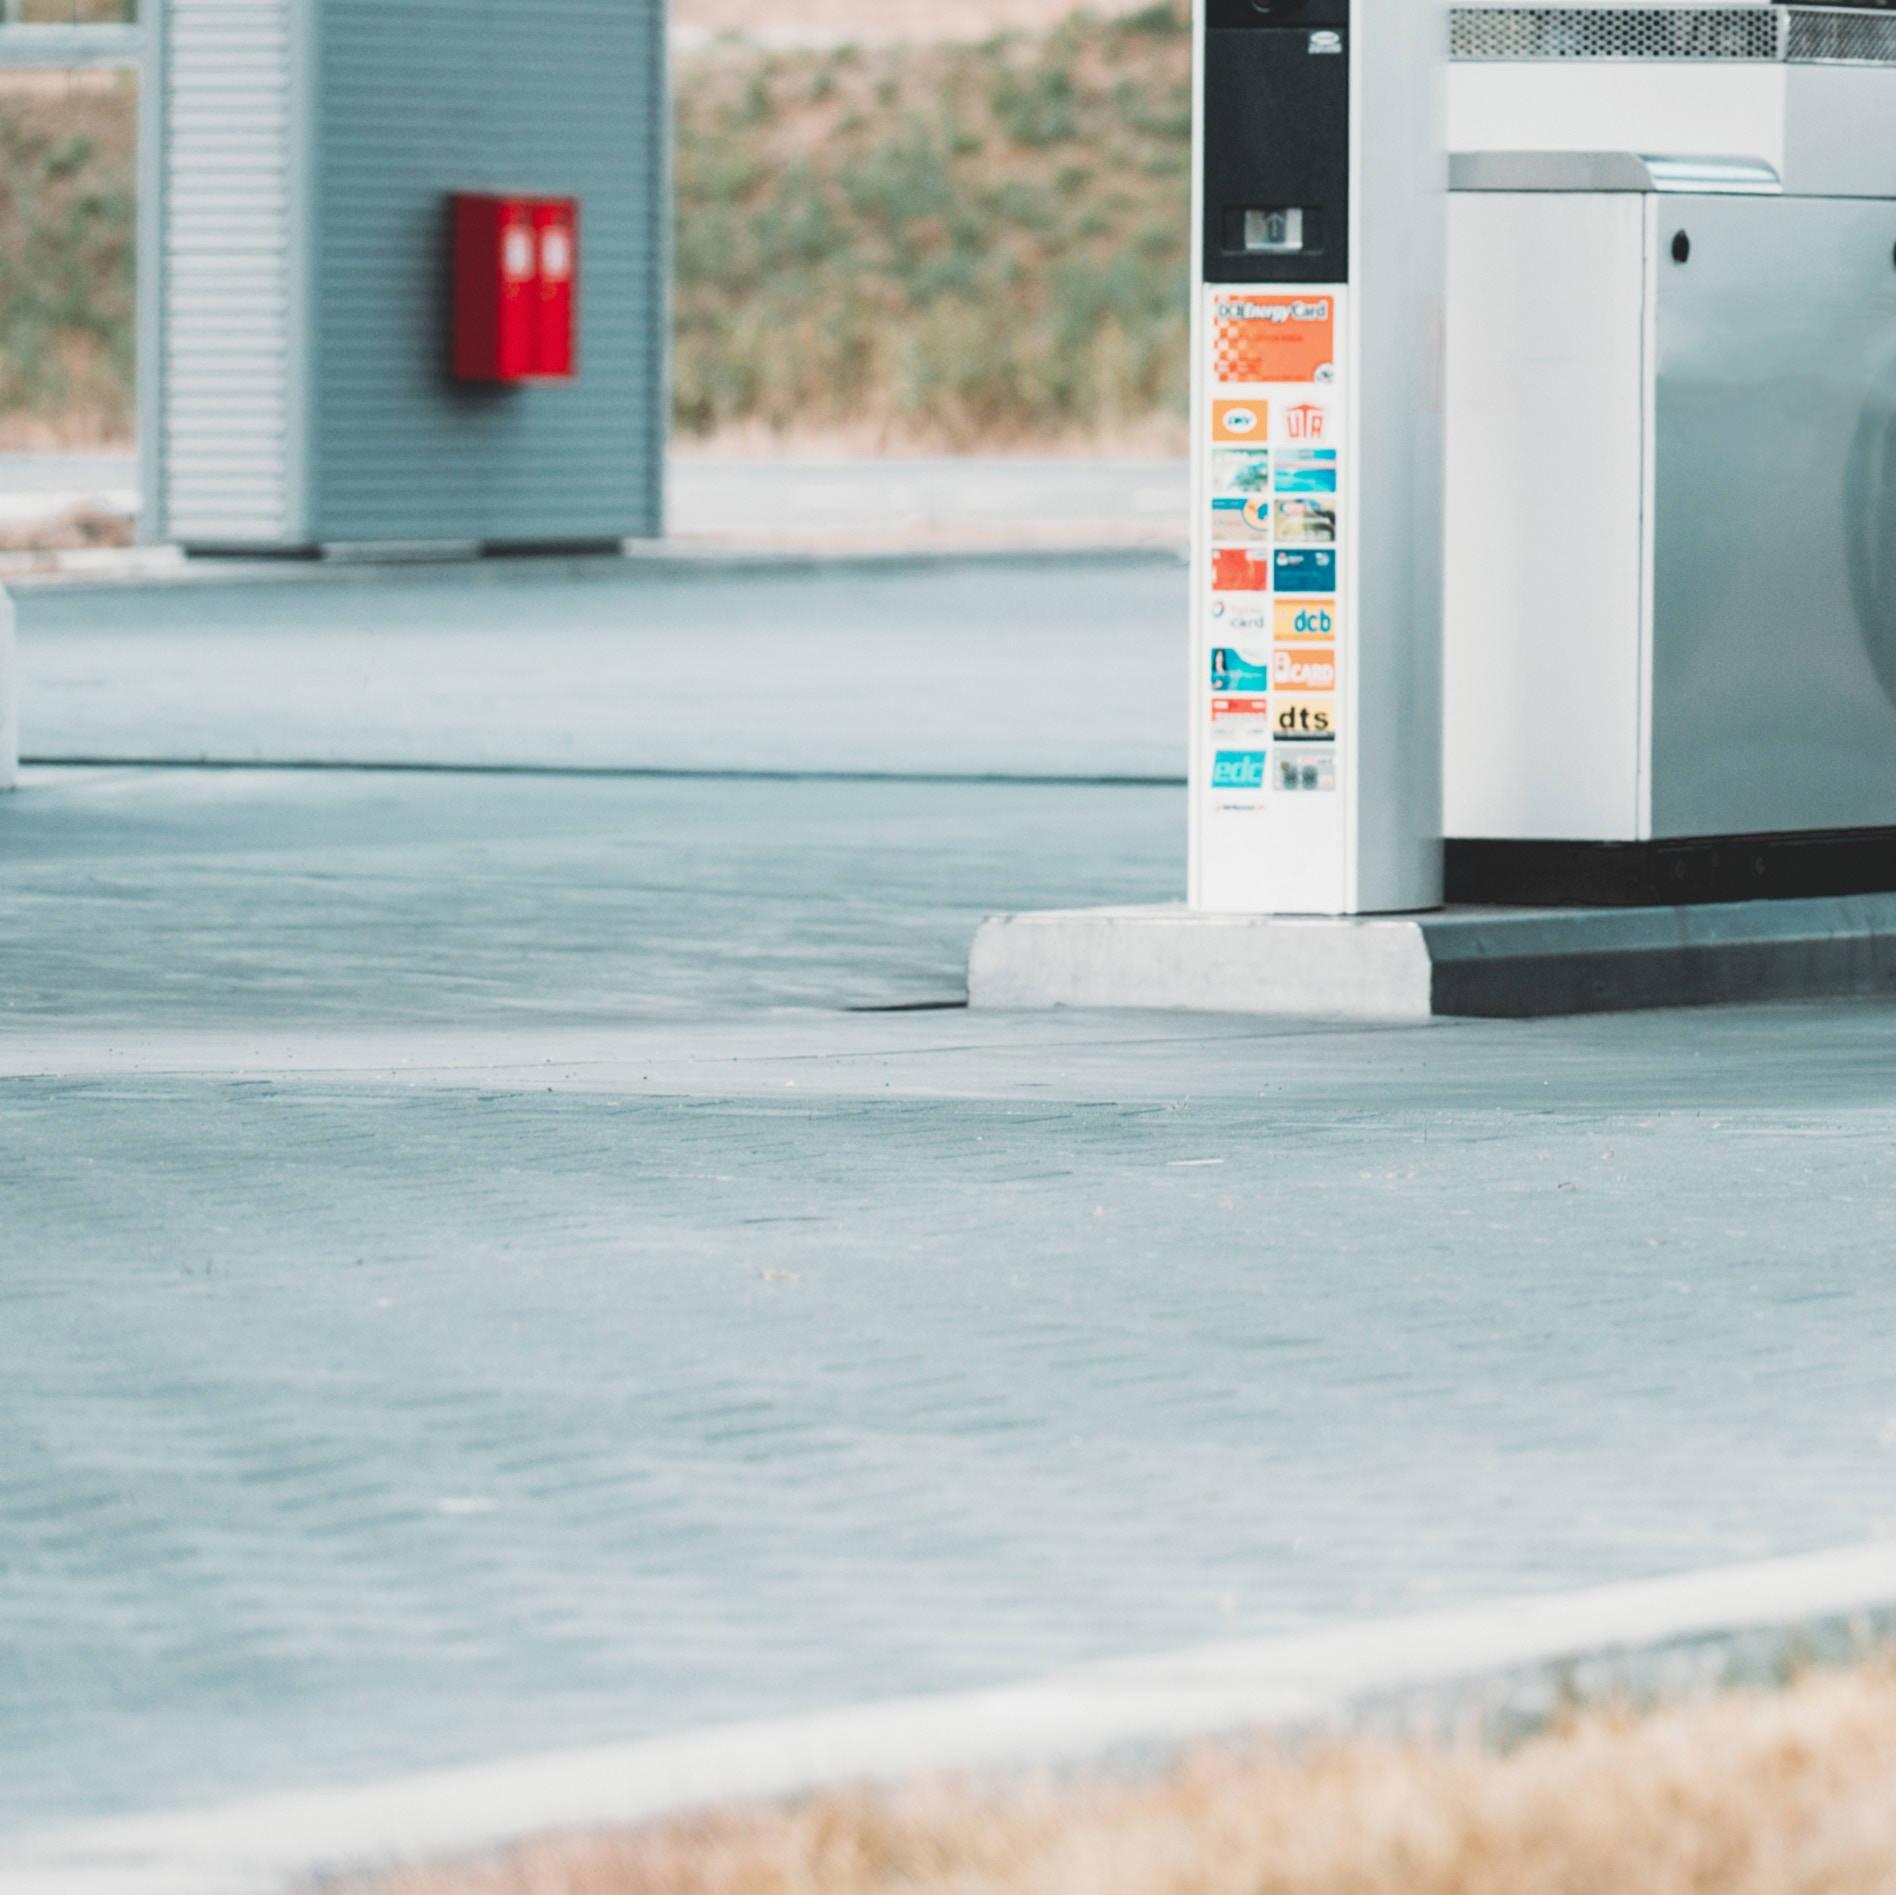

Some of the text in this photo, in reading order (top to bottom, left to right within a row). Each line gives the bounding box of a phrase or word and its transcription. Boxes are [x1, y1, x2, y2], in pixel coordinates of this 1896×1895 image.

[1286, 404, 1325, 438] UTA
[1294, 608, 1331, 633] dcb
[1279, 706, 1329, 730] dts
[1213, 755, 1263, 783] edc
